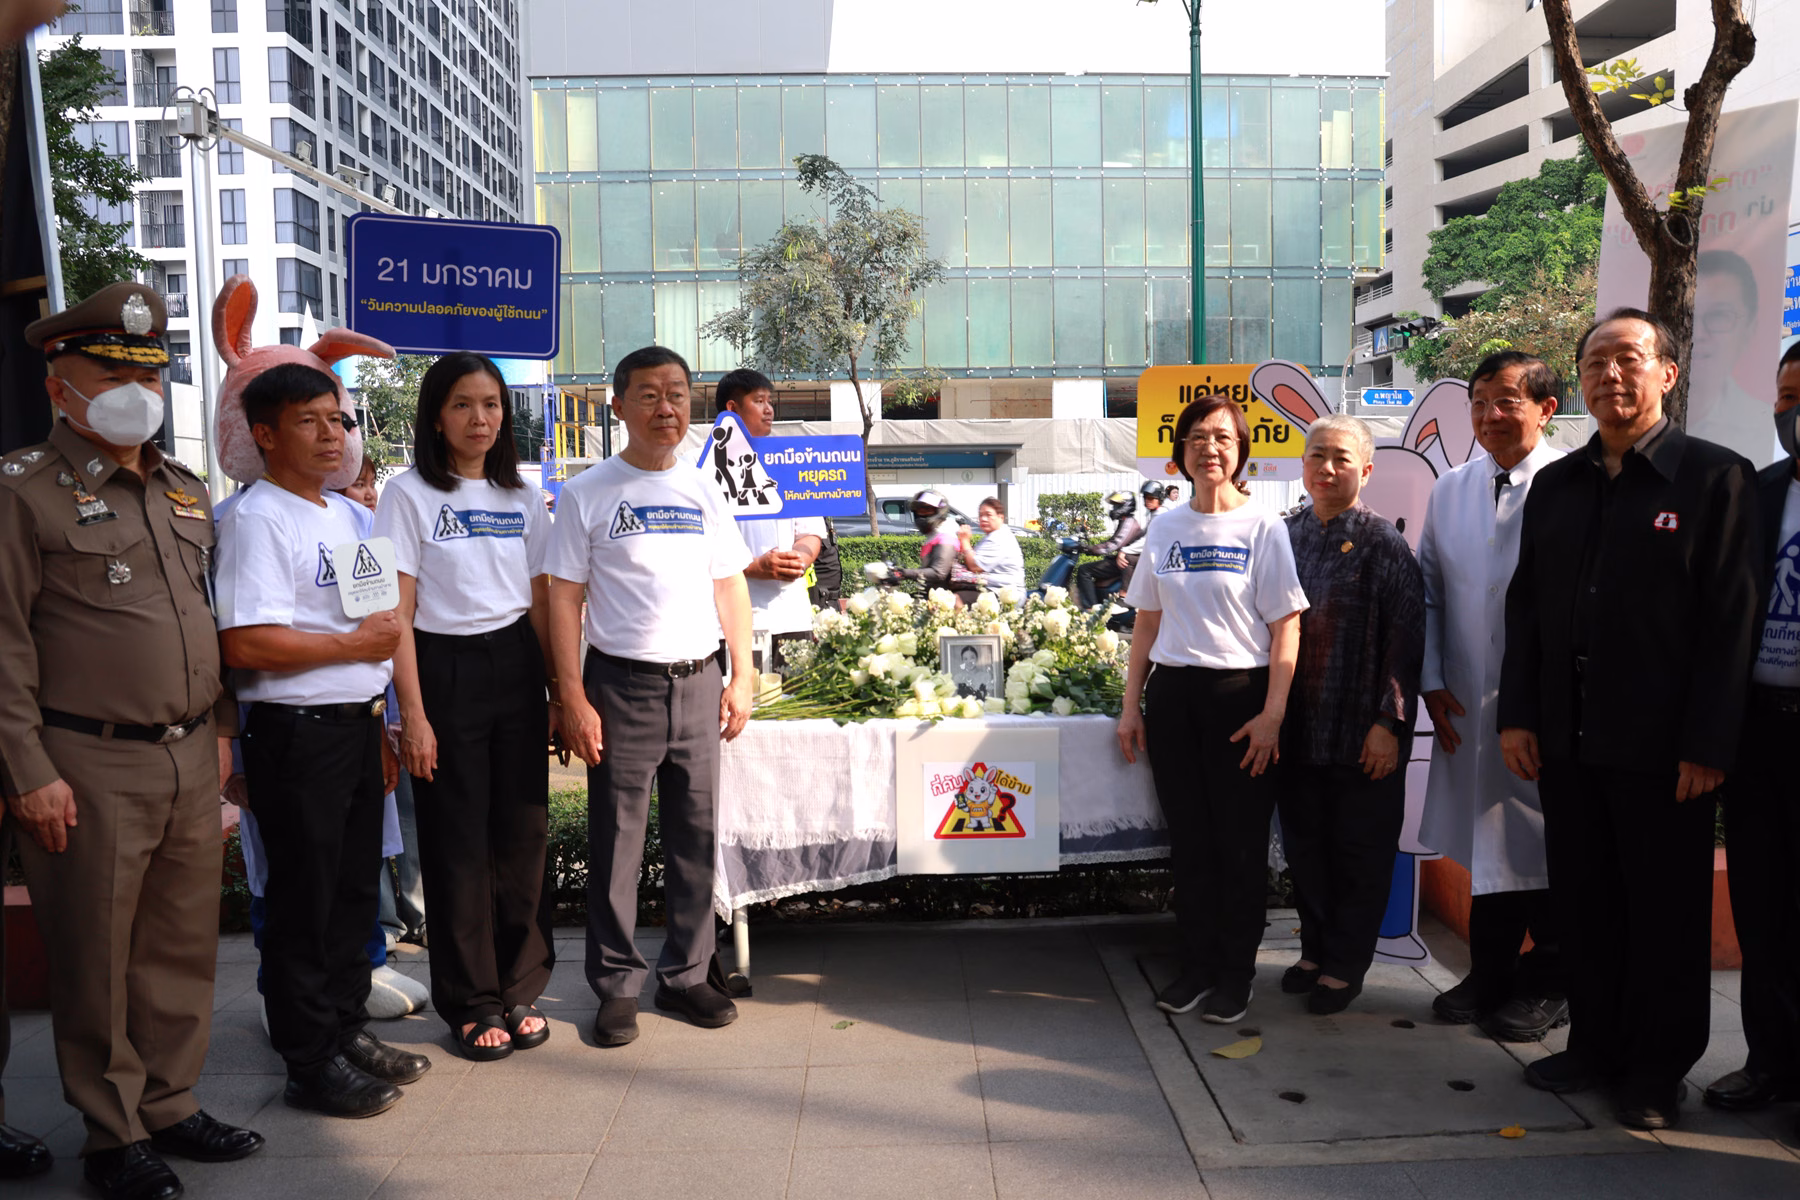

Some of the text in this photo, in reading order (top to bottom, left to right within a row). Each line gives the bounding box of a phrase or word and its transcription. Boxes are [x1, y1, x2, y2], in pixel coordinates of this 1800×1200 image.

[377, 257, 532, 290] 21 มกราคม
[360, 298, 548, 321] “วันความปลอดภัยของผู้ใช้ถนน”
[1179, 376, 1258, 412] แค่หยุ
[764, 447, 861, 465] ยกมือข้ามถนน
[798, 469, 847, 486] หยุดรถ
[784, 489, 862, 501] ให้คนข้ามทางม้าลาย
[469, 513, 523, 525] ยกมือข้ามถนน
[646, 509, 701, 521] ยกมือข้ามถนน
[1190, 548, 1247, 560] ยกมือข้ามถนน
[995, 769, 1032, 796] ได้ข้าม
